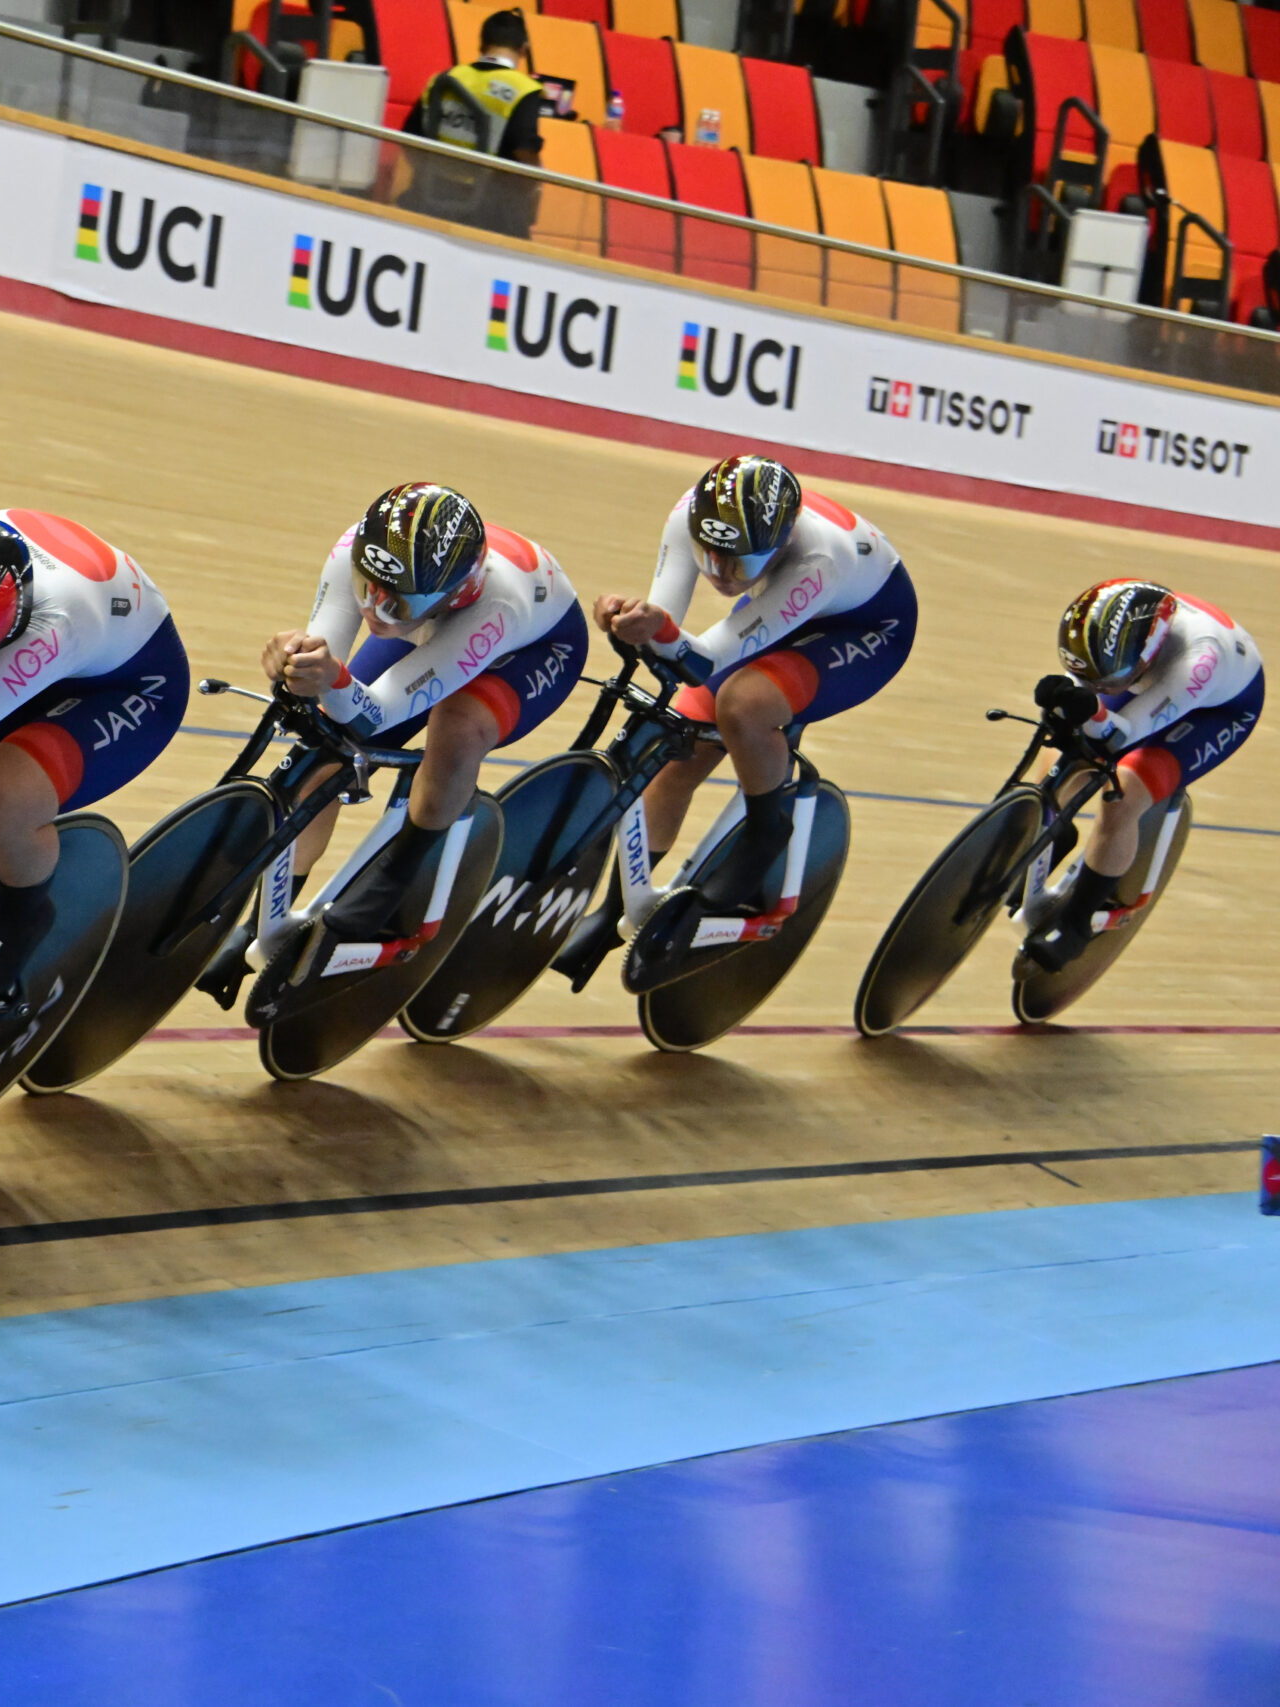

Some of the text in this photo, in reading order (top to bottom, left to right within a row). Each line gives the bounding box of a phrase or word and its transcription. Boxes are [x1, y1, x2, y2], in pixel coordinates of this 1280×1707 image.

[106, 189, 224, 289] UCI
[316, 239, 427, 334] UCI
[514, 285, 619, 374] UCI
[702, 326, 803, 411] UCI
[918, 384, 1033, 439] TISSOT
[1144, 426, 1251, 478] TISSOT
[332, 956, 375, 969] JAPAN
